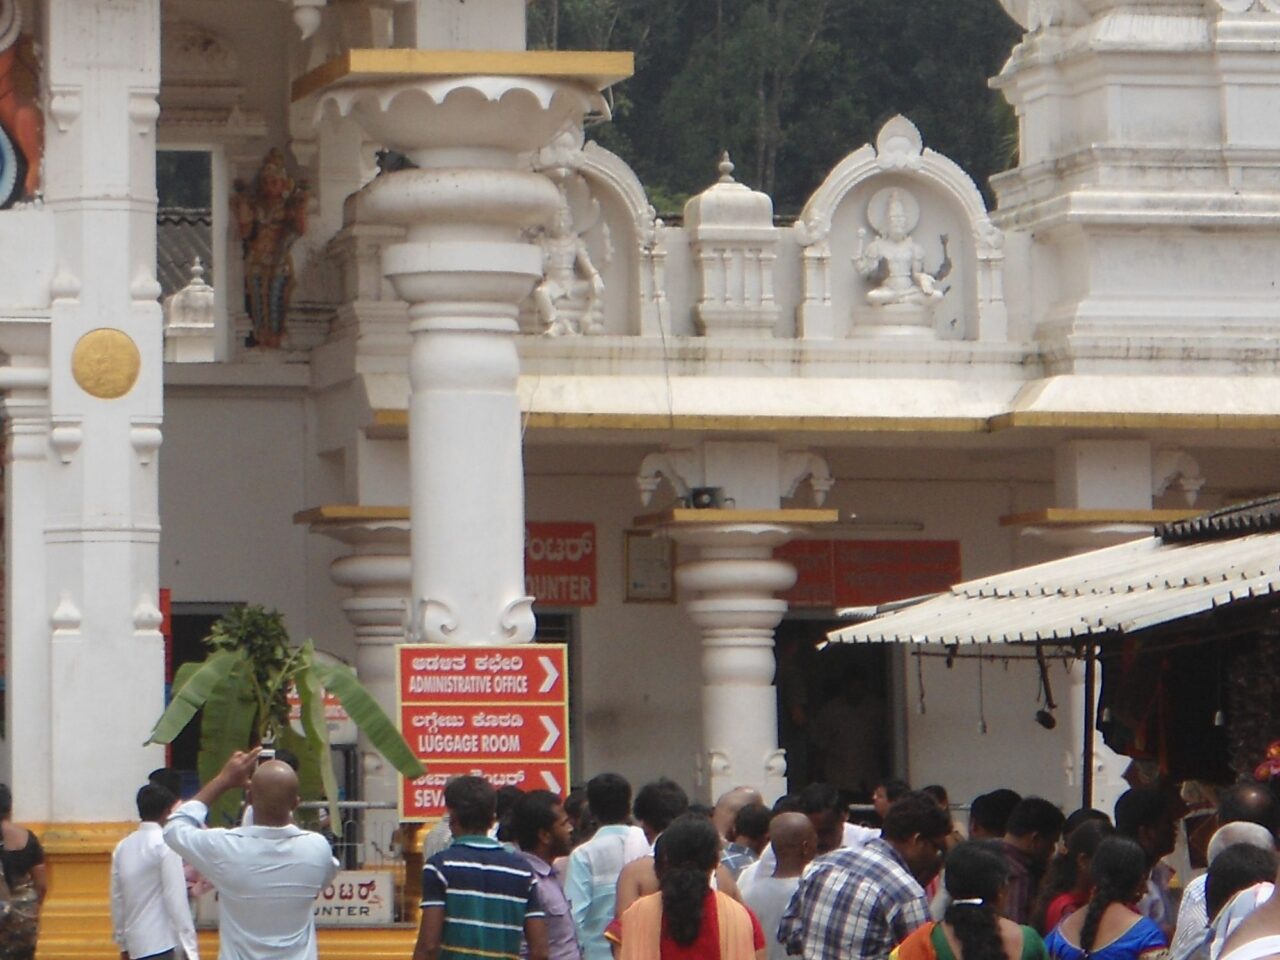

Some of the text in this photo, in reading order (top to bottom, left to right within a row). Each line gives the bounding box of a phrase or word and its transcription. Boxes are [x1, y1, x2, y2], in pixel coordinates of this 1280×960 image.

[525, 575, 592, 600] OUNTER
[408, 675, 528, 694] ADMINISTRATIVE OFFICE
[417, 734, 521, 753] LUGGAGE ROOM
